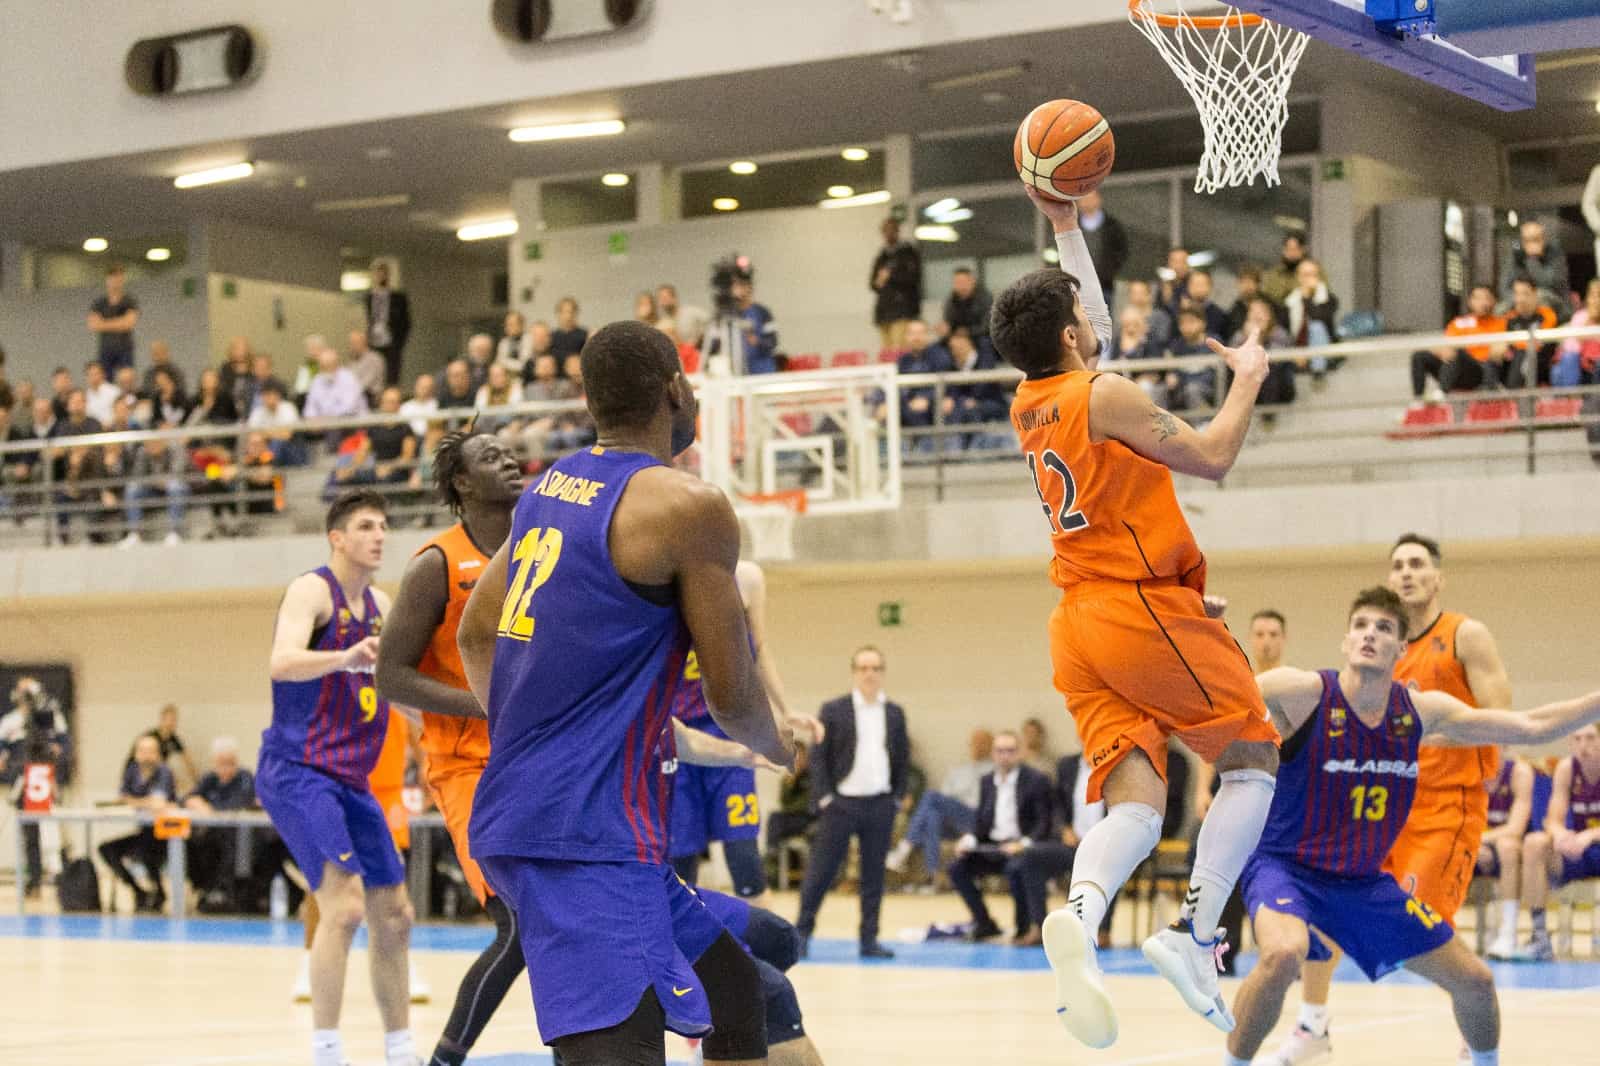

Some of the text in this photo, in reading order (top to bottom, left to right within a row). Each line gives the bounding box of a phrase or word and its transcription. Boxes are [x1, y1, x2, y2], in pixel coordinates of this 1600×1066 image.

[496, 526, 564, 642] 12
[358, 686, 378, 723] 9
[726, 793, 760, 827] 23
[1349, 785, 1389, 821] 13
